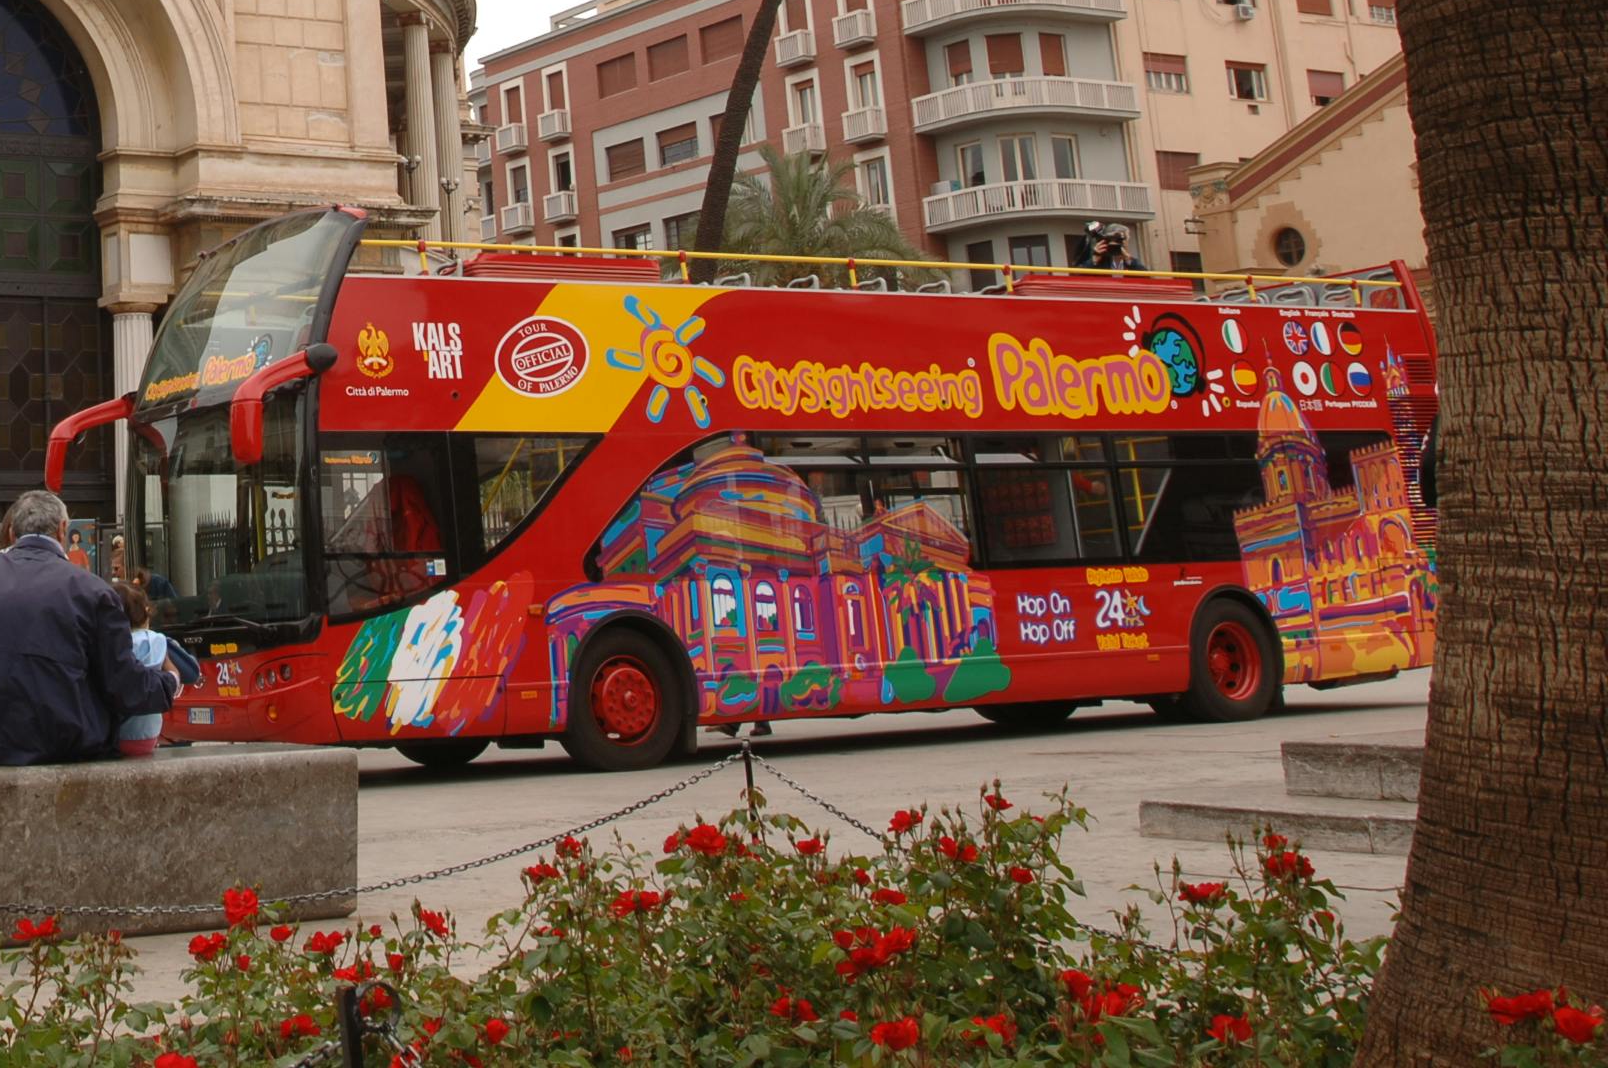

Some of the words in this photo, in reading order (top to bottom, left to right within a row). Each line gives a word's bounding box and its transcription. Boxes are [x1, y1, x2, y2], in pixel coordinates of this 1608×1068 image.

[412, 322, 463, 351] KALS
[519, 323, 548, 338] TOUR
[514, 344, 571, 371] OFFICIAL
[517, 379, 533, 393] OF
[539, 365, 579, 393] PALERMO
[988, 332, 1170, 420] Palermo
[345, 386, 367, 397] Città
[367, 387, 375, 397] di
[375, 387, 410, 397] Palermo
[1017, 593, 1046, 617] Hop
[1050, 592, 1070, 614] On
[1095, 590, 1125, 629] 24
[1020, 621, 1049, 644] Hop
[1053, 619, 1076, 641] Off
[215, 662, 230, 685] 24
